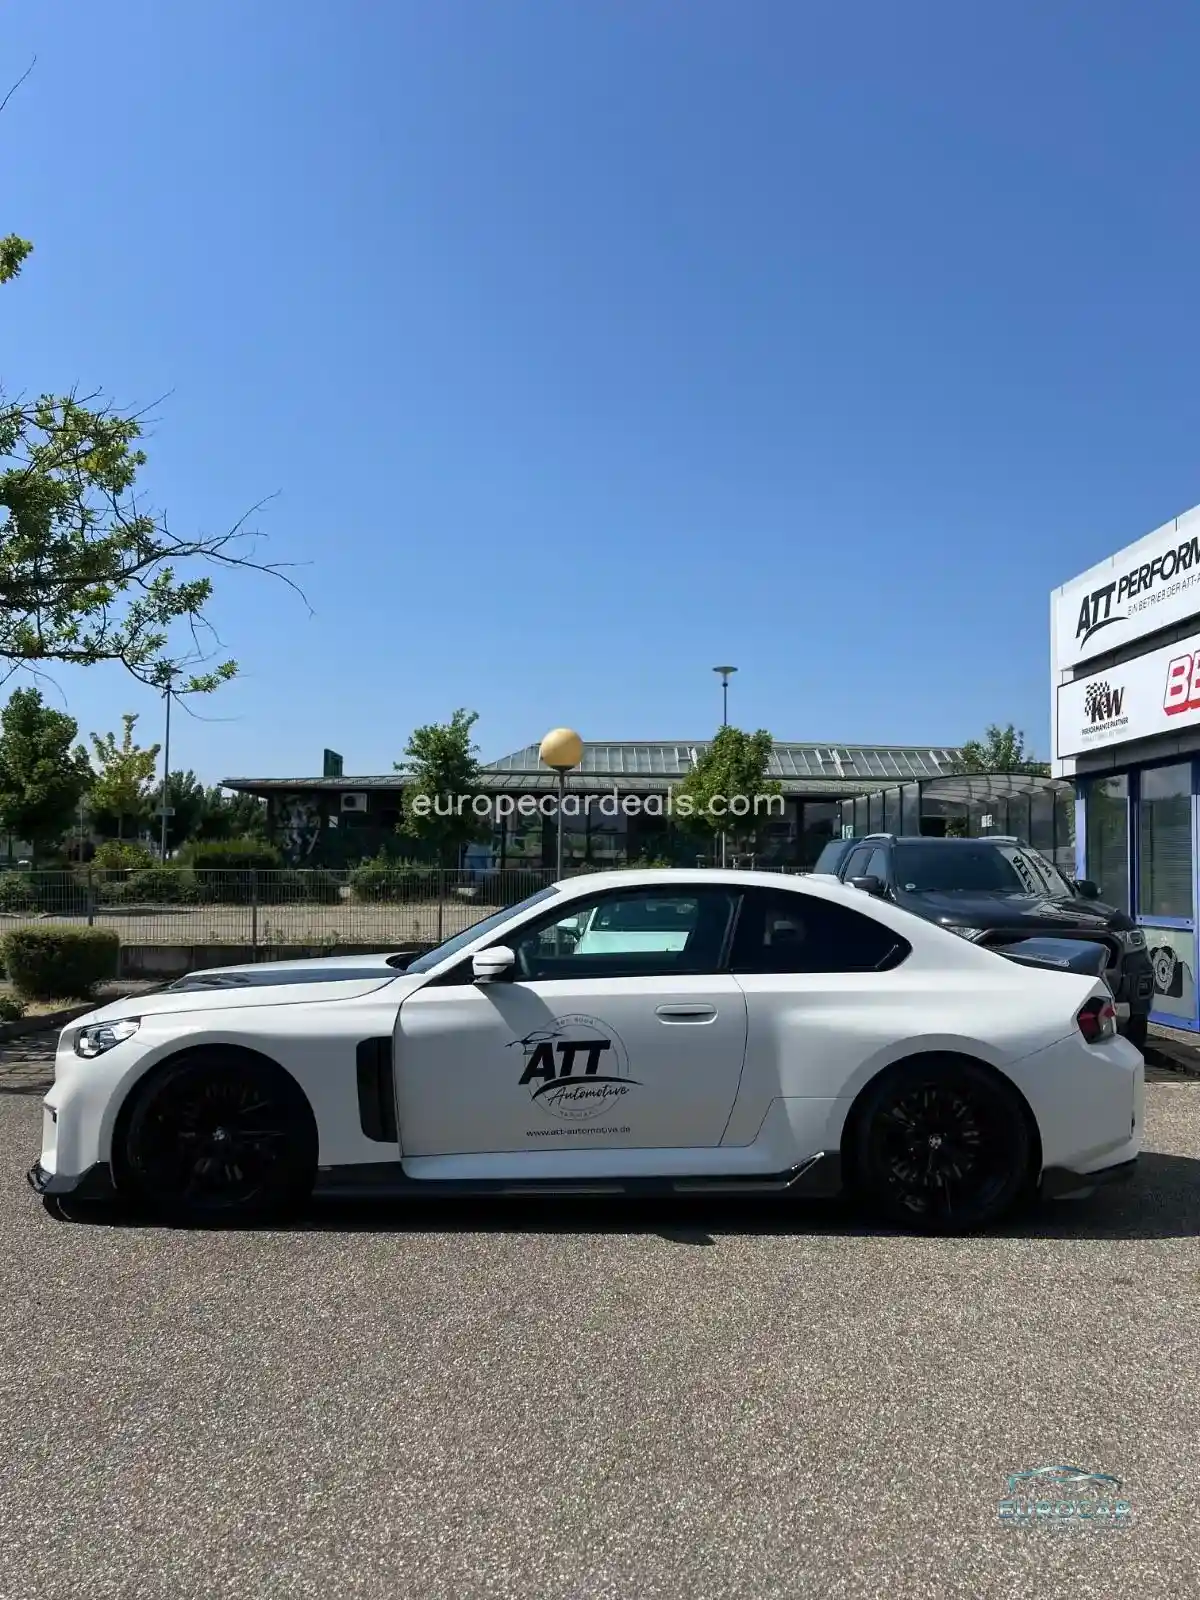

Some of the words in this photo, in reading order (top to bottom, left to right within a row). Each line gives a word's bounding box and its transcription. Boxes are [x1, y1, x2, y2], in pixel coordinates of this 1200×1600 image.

[1075, 580, 1117, 639] ATT
[518, 1039, 612, 1085] ATT
[547, 1084, 630, 1107] Automotive
[526, 1125, 631, 1138] www.att-automotive.de
